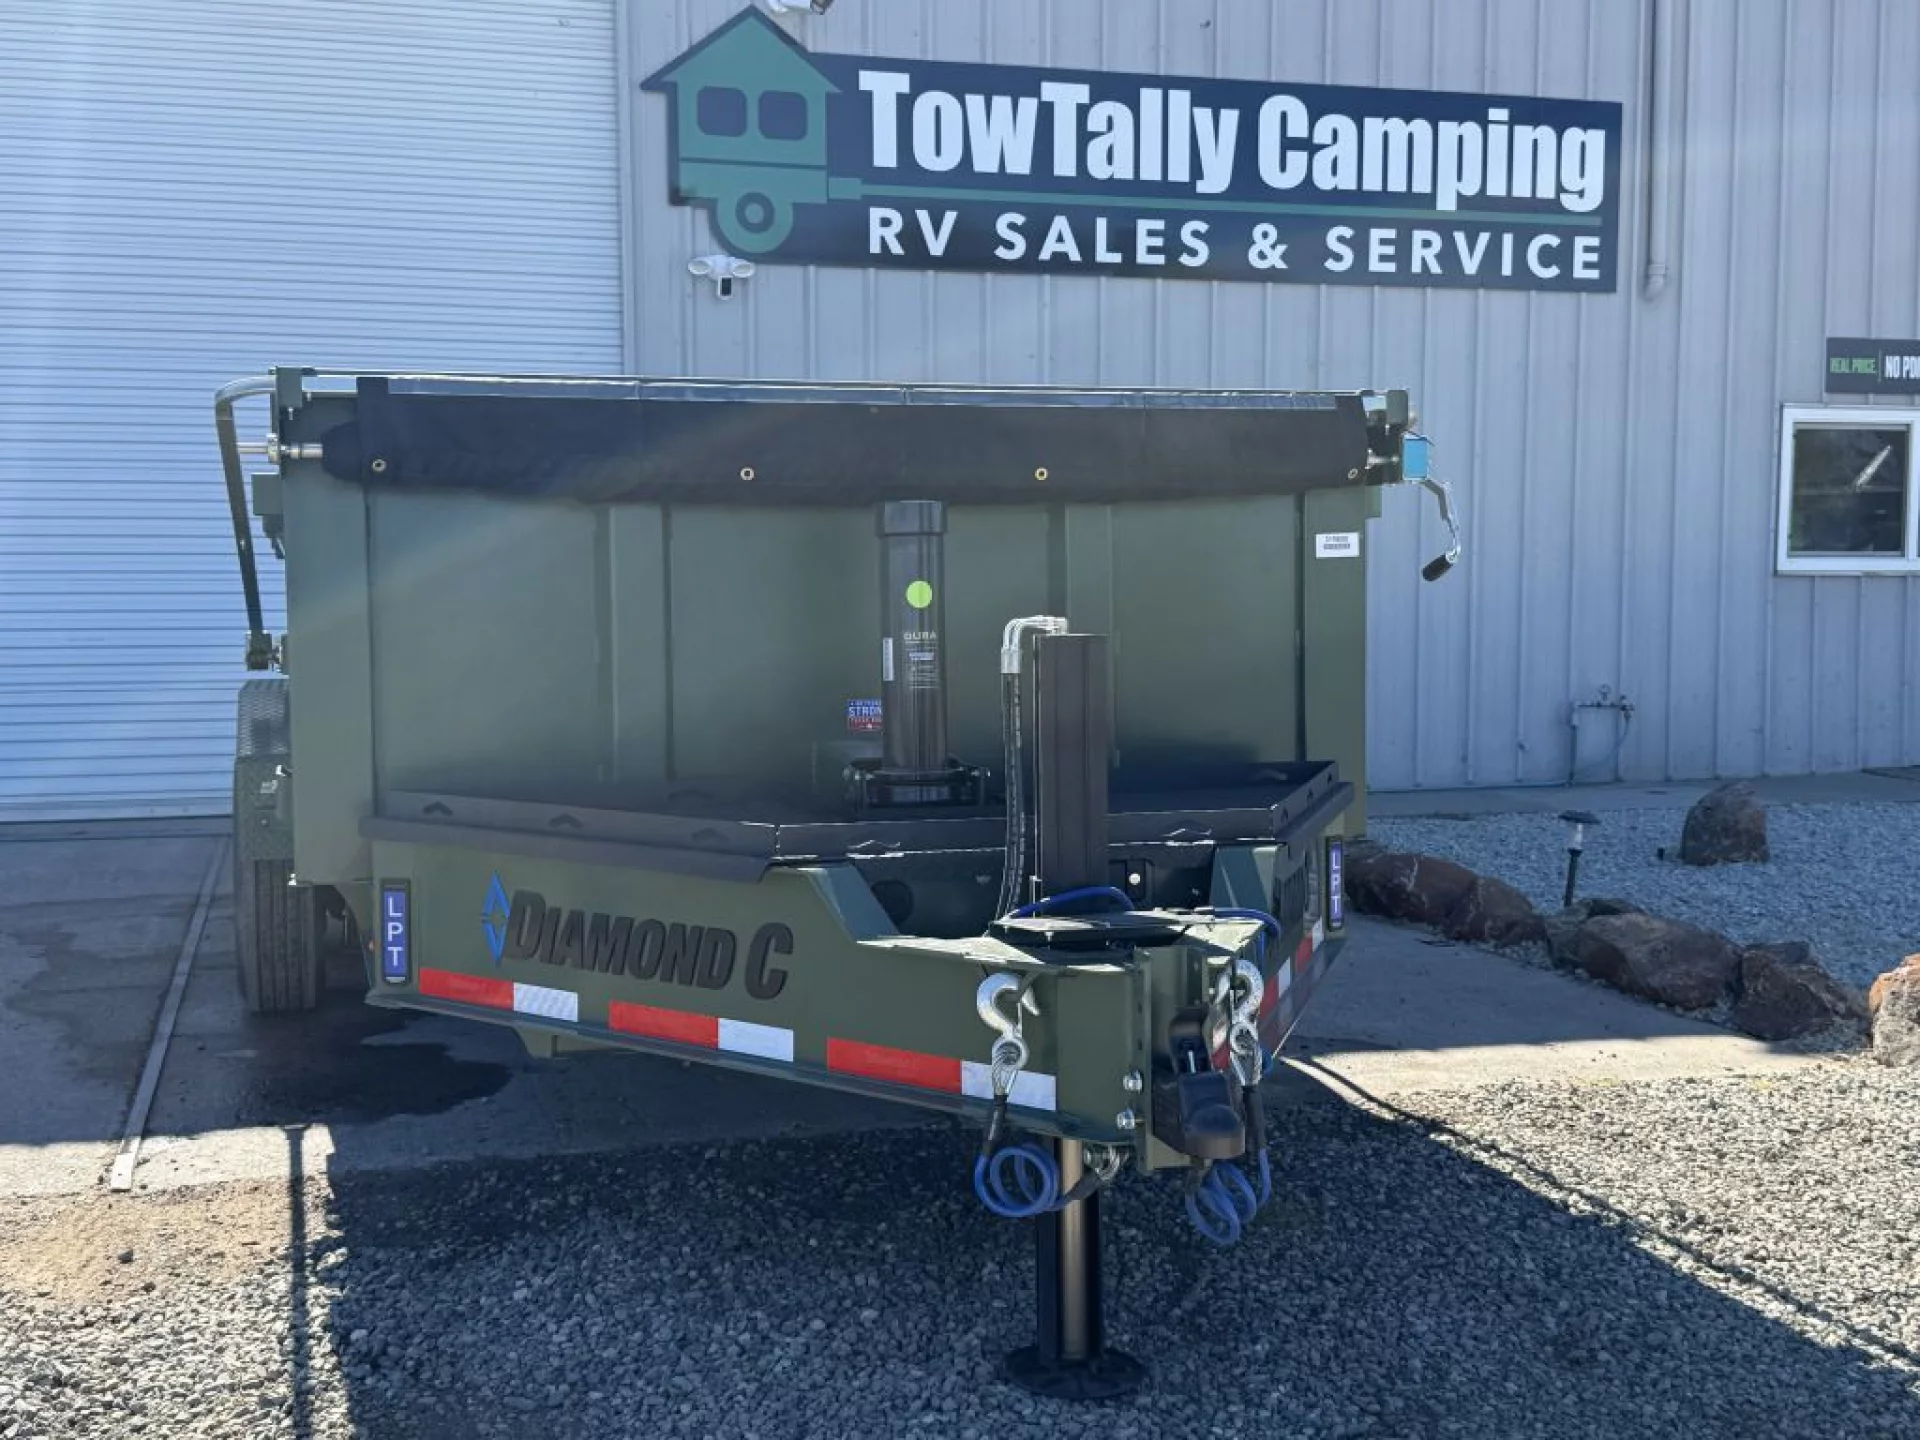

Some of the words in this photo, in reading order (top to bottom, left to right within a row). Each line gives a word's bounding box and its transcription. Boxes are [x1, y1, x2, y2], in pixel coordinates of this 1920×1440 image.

[858, 69, 1240, 194] TowTally
[1257, 94, 1606, 212] Camping
[868, 206, 959, 256] RV
[994, 212, 1211, 268] SALES
[1247, 222, 1288, 270] &
[1323, 224, 1601, 280] SERVICE
[1885, 355, 1900, 379] NO
[1331, 852, 1341, 914] LPT
[387, 896, 404, 967] LPT
[502, 889, 737, 991] DIAMOND
[744, 922, 794, 1000] C
